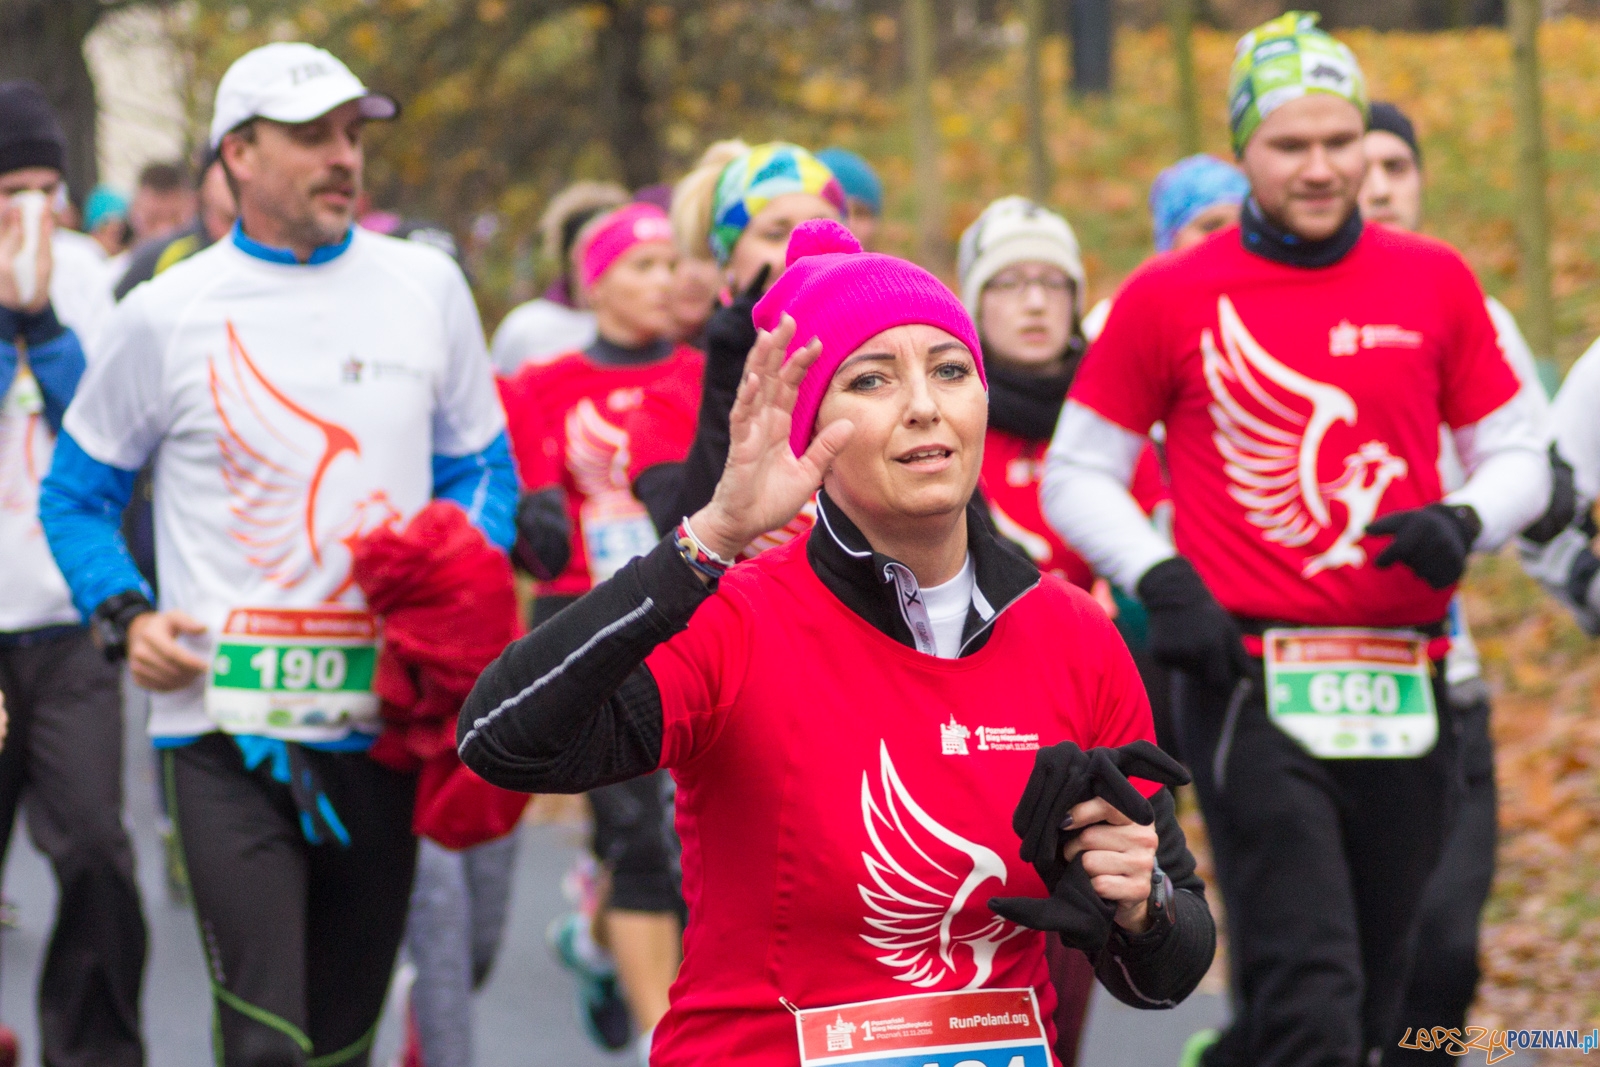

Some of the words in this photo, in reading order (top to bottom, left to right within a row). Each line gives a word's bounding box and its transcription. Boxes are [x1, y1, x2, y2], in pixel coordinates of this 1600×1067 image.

[250, 648, 346, 689] 190
[1310, 673, 1398, 713] 660
[860, 1020, 875, 1041] 1
[949, 1012, 1029, 1029] RunPoland.org
